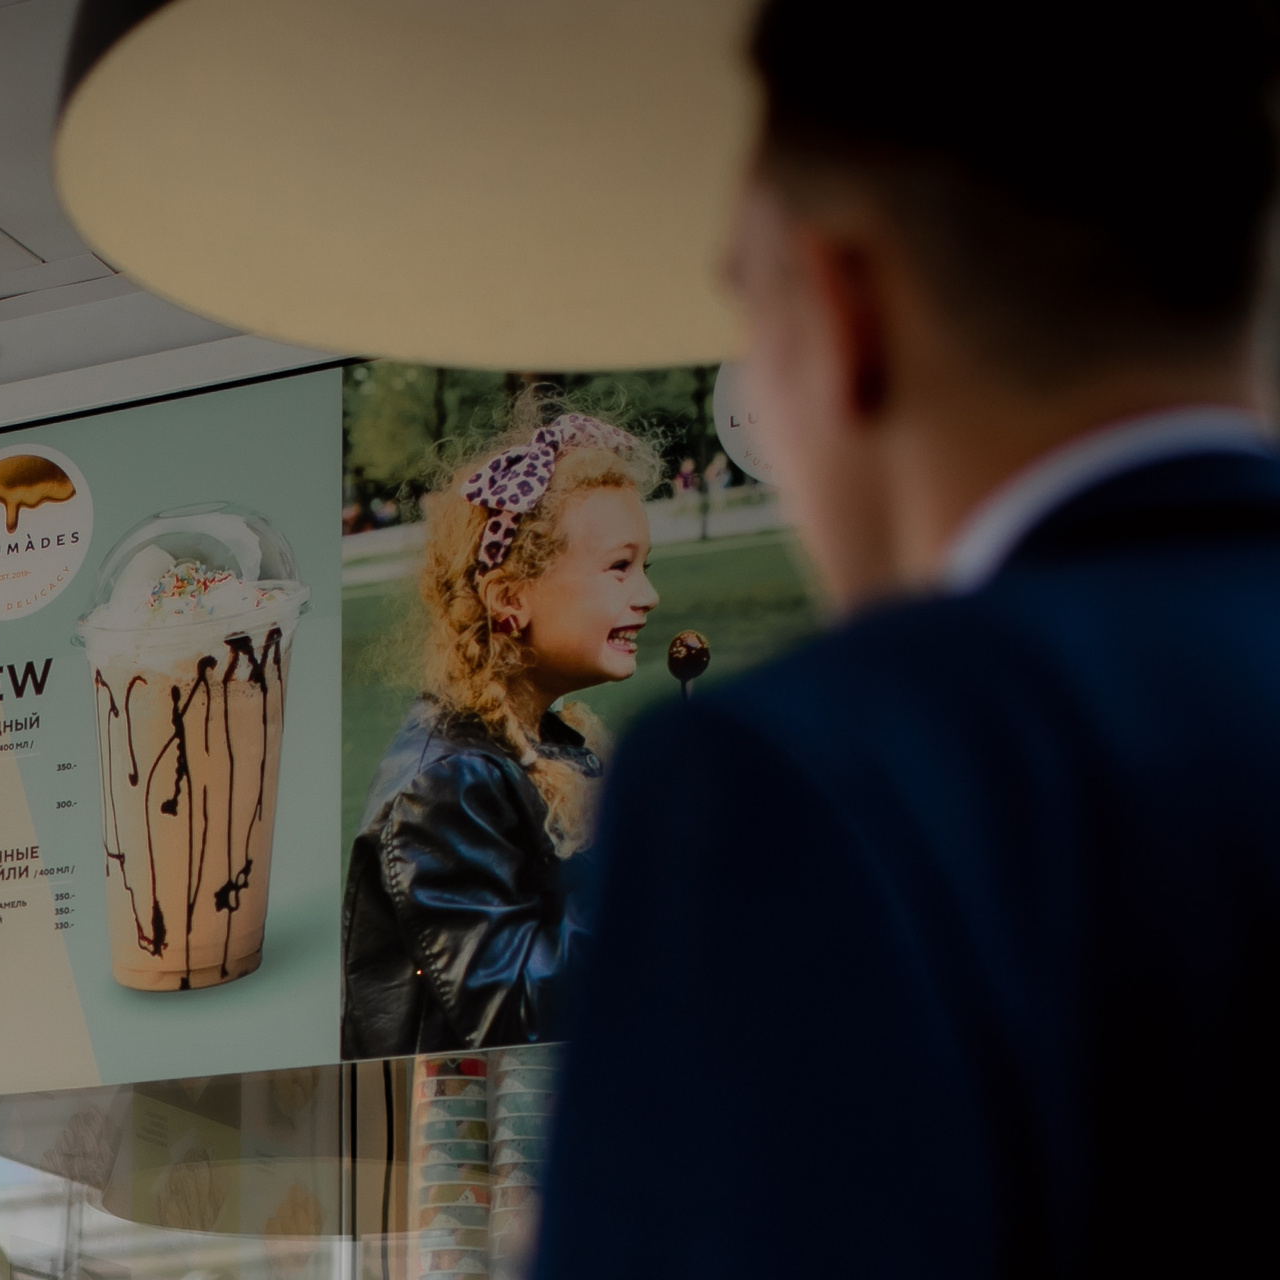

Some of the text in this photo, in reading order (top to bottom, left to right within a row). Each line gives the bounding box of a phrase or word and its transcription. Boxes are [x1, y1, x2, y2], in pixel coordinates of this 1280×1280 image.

[6, 565, 69, 611] DELICACY
[16, 741, 29, 751] МЛ
[39, 868, 55, 876] 400
[56, 866, 69, 875] МЛ
